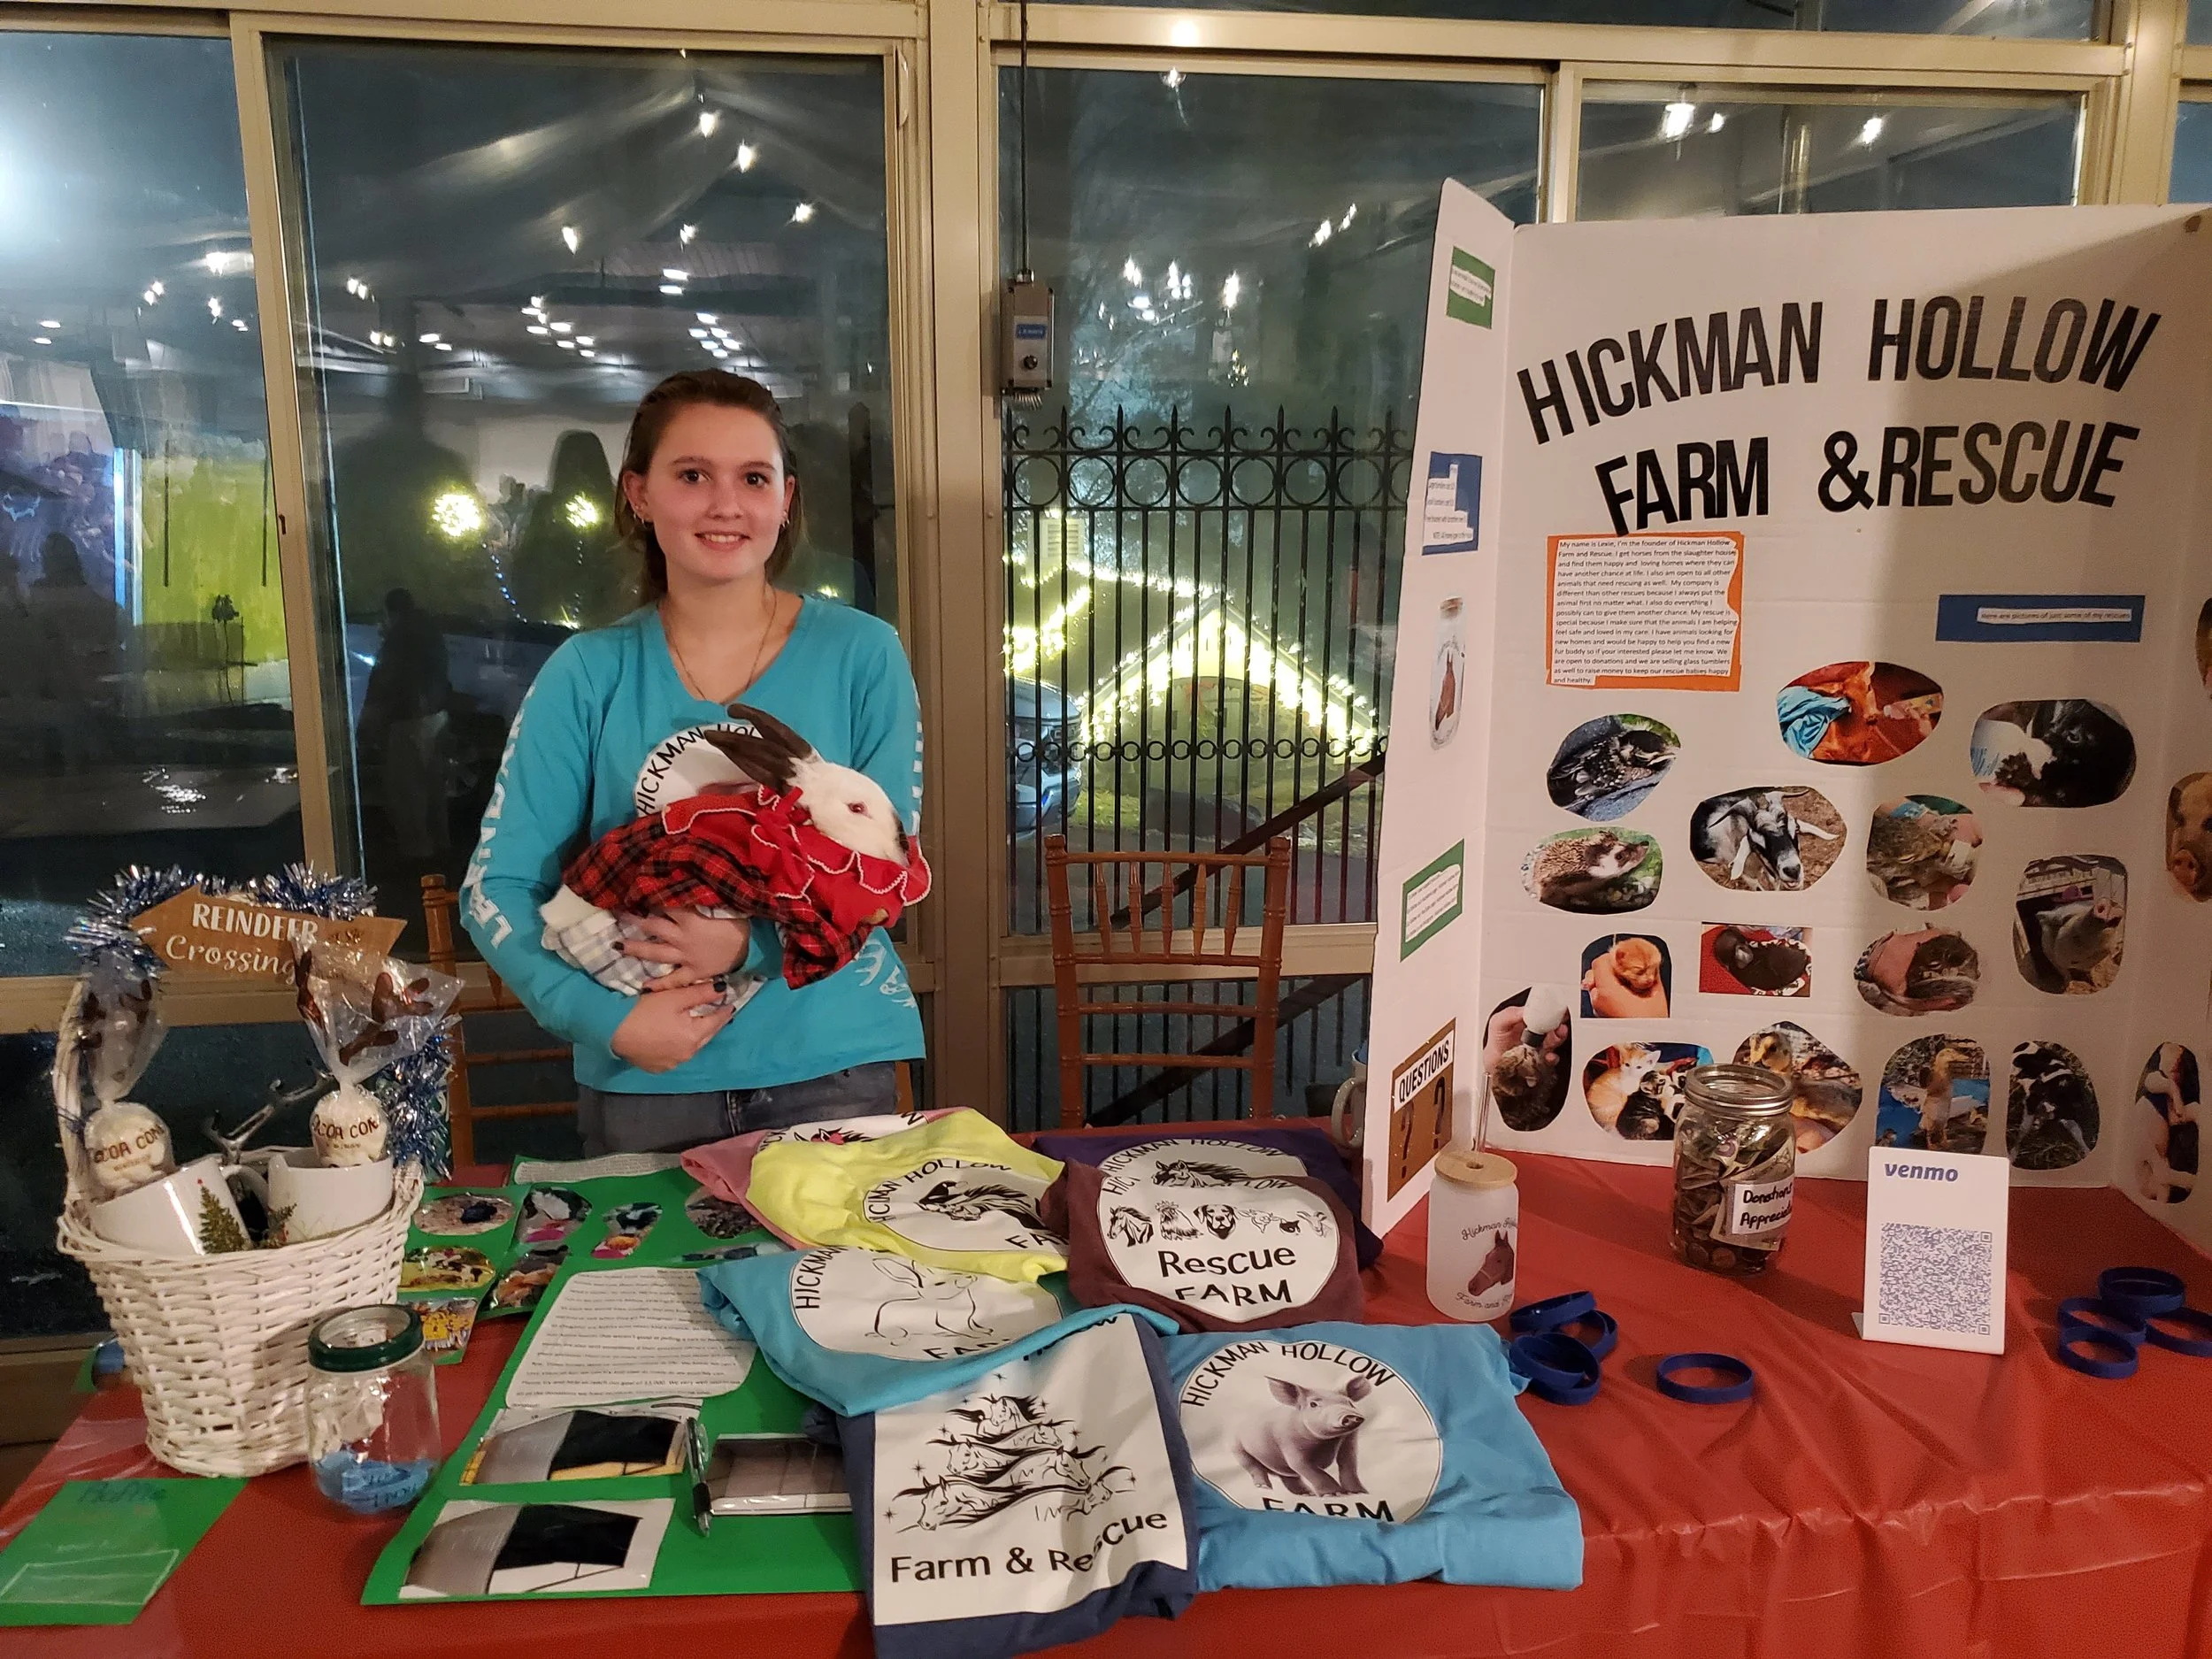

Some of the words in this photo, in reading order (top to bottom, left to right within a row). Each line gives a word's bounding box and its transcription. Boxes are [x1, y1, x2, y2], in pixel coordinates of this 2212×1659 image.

[1517, 302, 1823, 444] HICKMAN
[1868, 295, 2161, 391] HOLLOW
[1594, 436, 1769, 536] FARM
[637, 726, 705, 815] HICKMAN
[192, 902, 319, 945] REINDEER
[165, 933, 298, 985] Crossing
[1399, 1040, 1449, 1103] QUESTIONS
[904, 1159, 1012, 1184] HOLLOW
[1103, 1138, 1179, 1173] HICKMAN
[1884, 1163, 1959, 1182] venmo
[1461, 1221, 1502, 1240] Hickman
[1158, 1247, 1297, 1278] Rescue
[1174, 1279, 1293, 1307] FARM
[1182, 1341, 1270, 1408] HICKMAN
[1281, 1342, 1397, 1386] HOLLOW
[891, 1555, 991, 1583] Farm
[1005, 1547, 1035, 1575] &
[1048, 1511, 1168, 1572] Rescue
